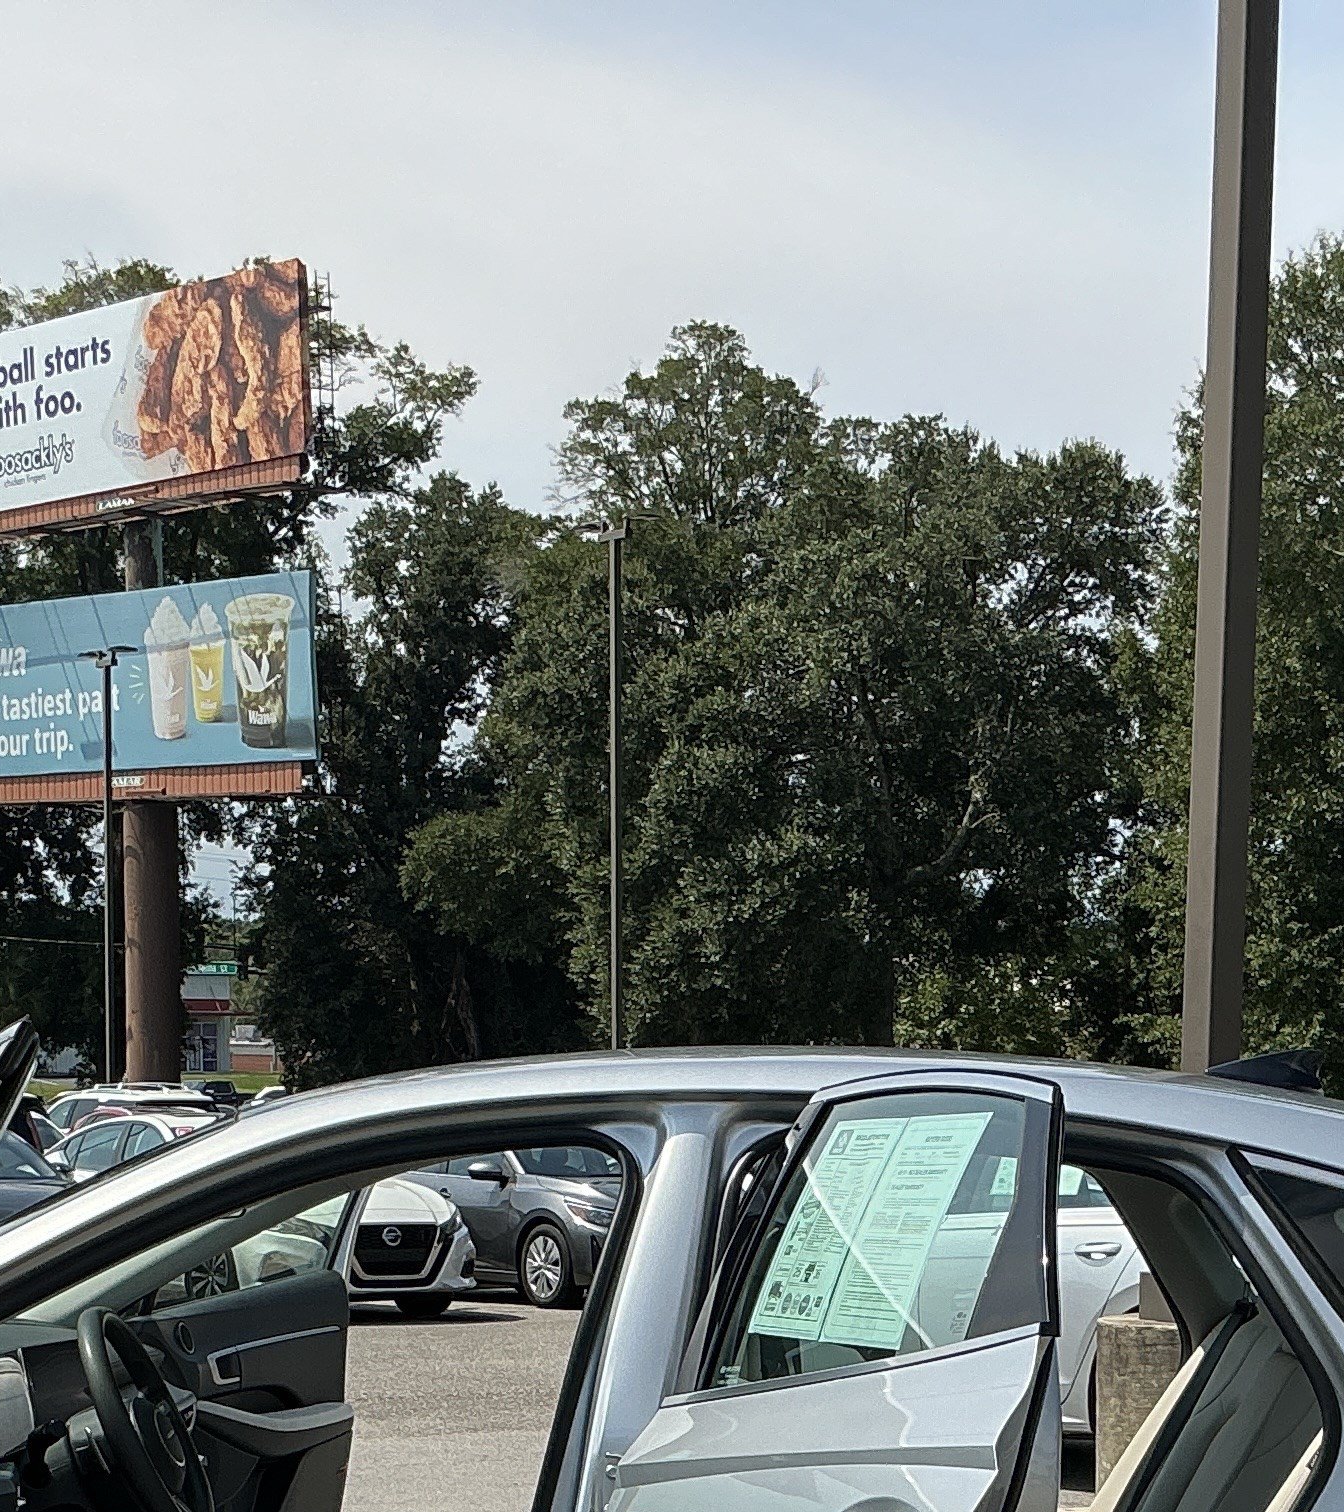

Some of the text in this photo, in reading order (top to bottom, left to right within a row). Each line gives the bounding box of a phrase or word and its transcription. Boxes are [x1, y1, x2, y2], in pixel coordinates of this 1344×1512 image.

[44, 337, 112, 378] starts
[34, 384, 82, 421] foo.
[2, 687, 73, 721] tastiest
[78, 683, 120, 721] pat
[34, 722, 74, 760] trip.
